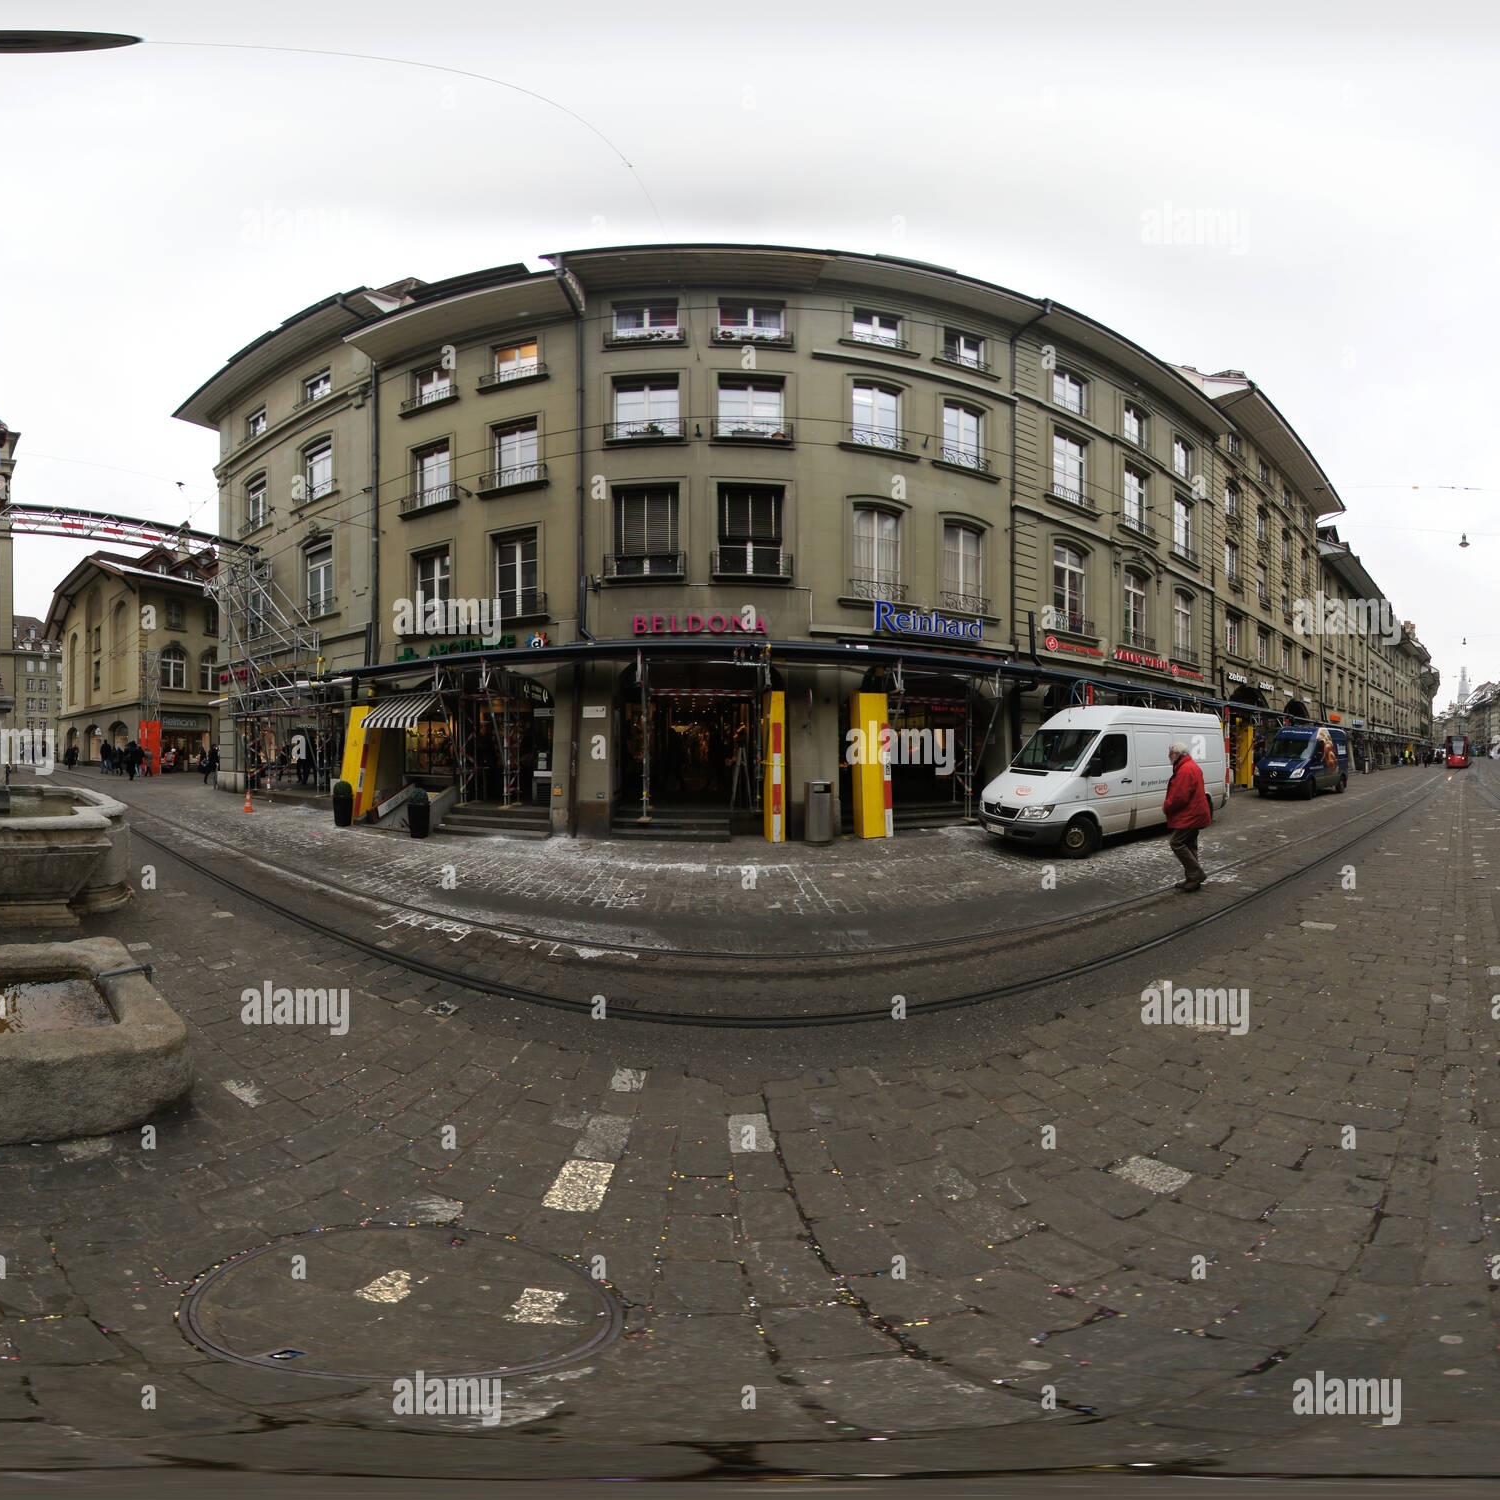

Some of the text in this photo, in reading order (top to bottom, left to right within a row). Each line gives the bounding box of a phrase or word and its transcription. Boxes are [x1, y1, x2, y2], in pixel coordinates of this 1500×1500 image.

[633, 615, 767, 633] BELDONA
[874, 600, 983, 639] Reinhard
[1228, 672, 1248, 684] zebra
[1259, 681, 1275, 691] zebra
